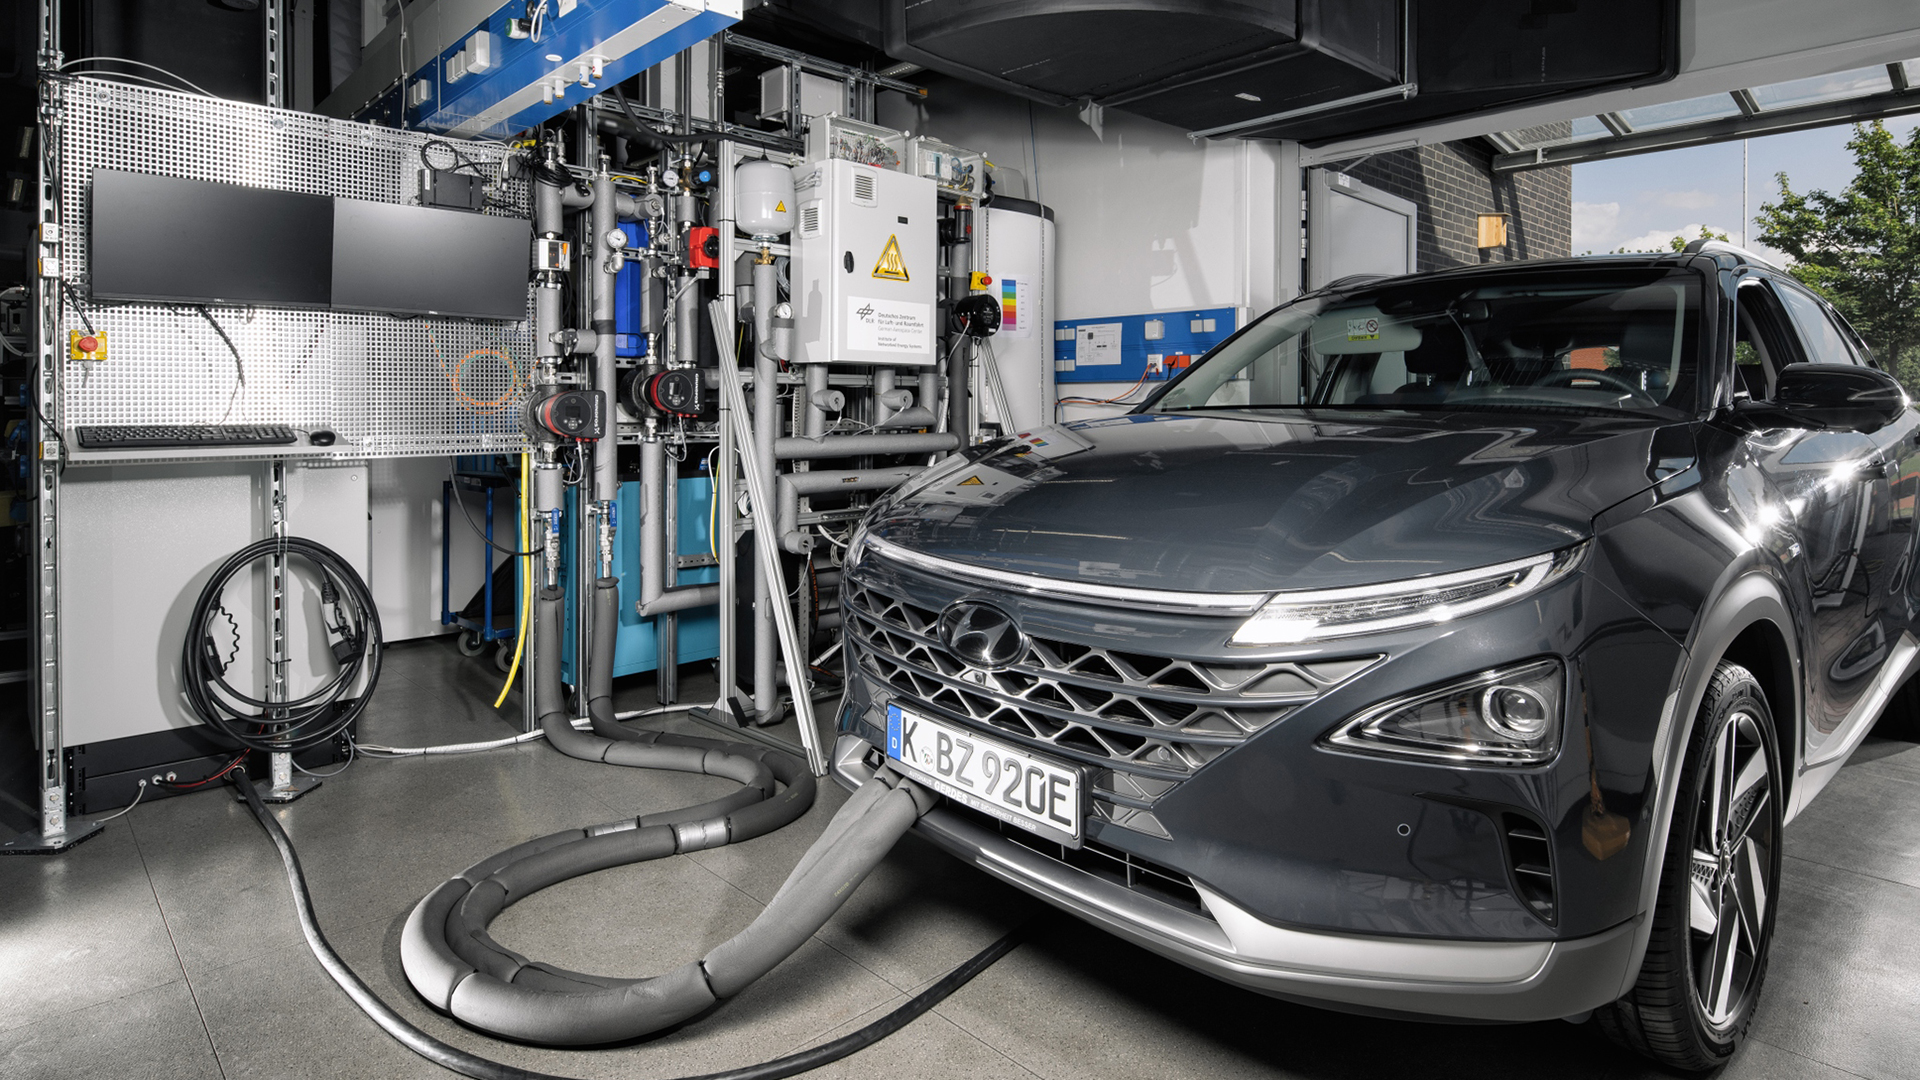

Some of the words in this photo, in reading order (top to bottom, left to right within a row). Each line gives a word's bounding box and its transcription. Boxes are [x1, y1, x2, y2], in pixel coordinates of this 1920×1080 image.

[892, 736, 897, 749] D
[902, 716, 918, 763] K
[936, 731, 974, 788] BZ
[981, 750, 1072, 827] 920E
[908, 770, 932, 786] AUTOHAUS
[934, 781, 968, 804] GERDES
[970, 799, 980, 809] MIT
[981, 803, 1012, 820] SICHERHEIT
[1013, 816, 1037, 831] BESSER
